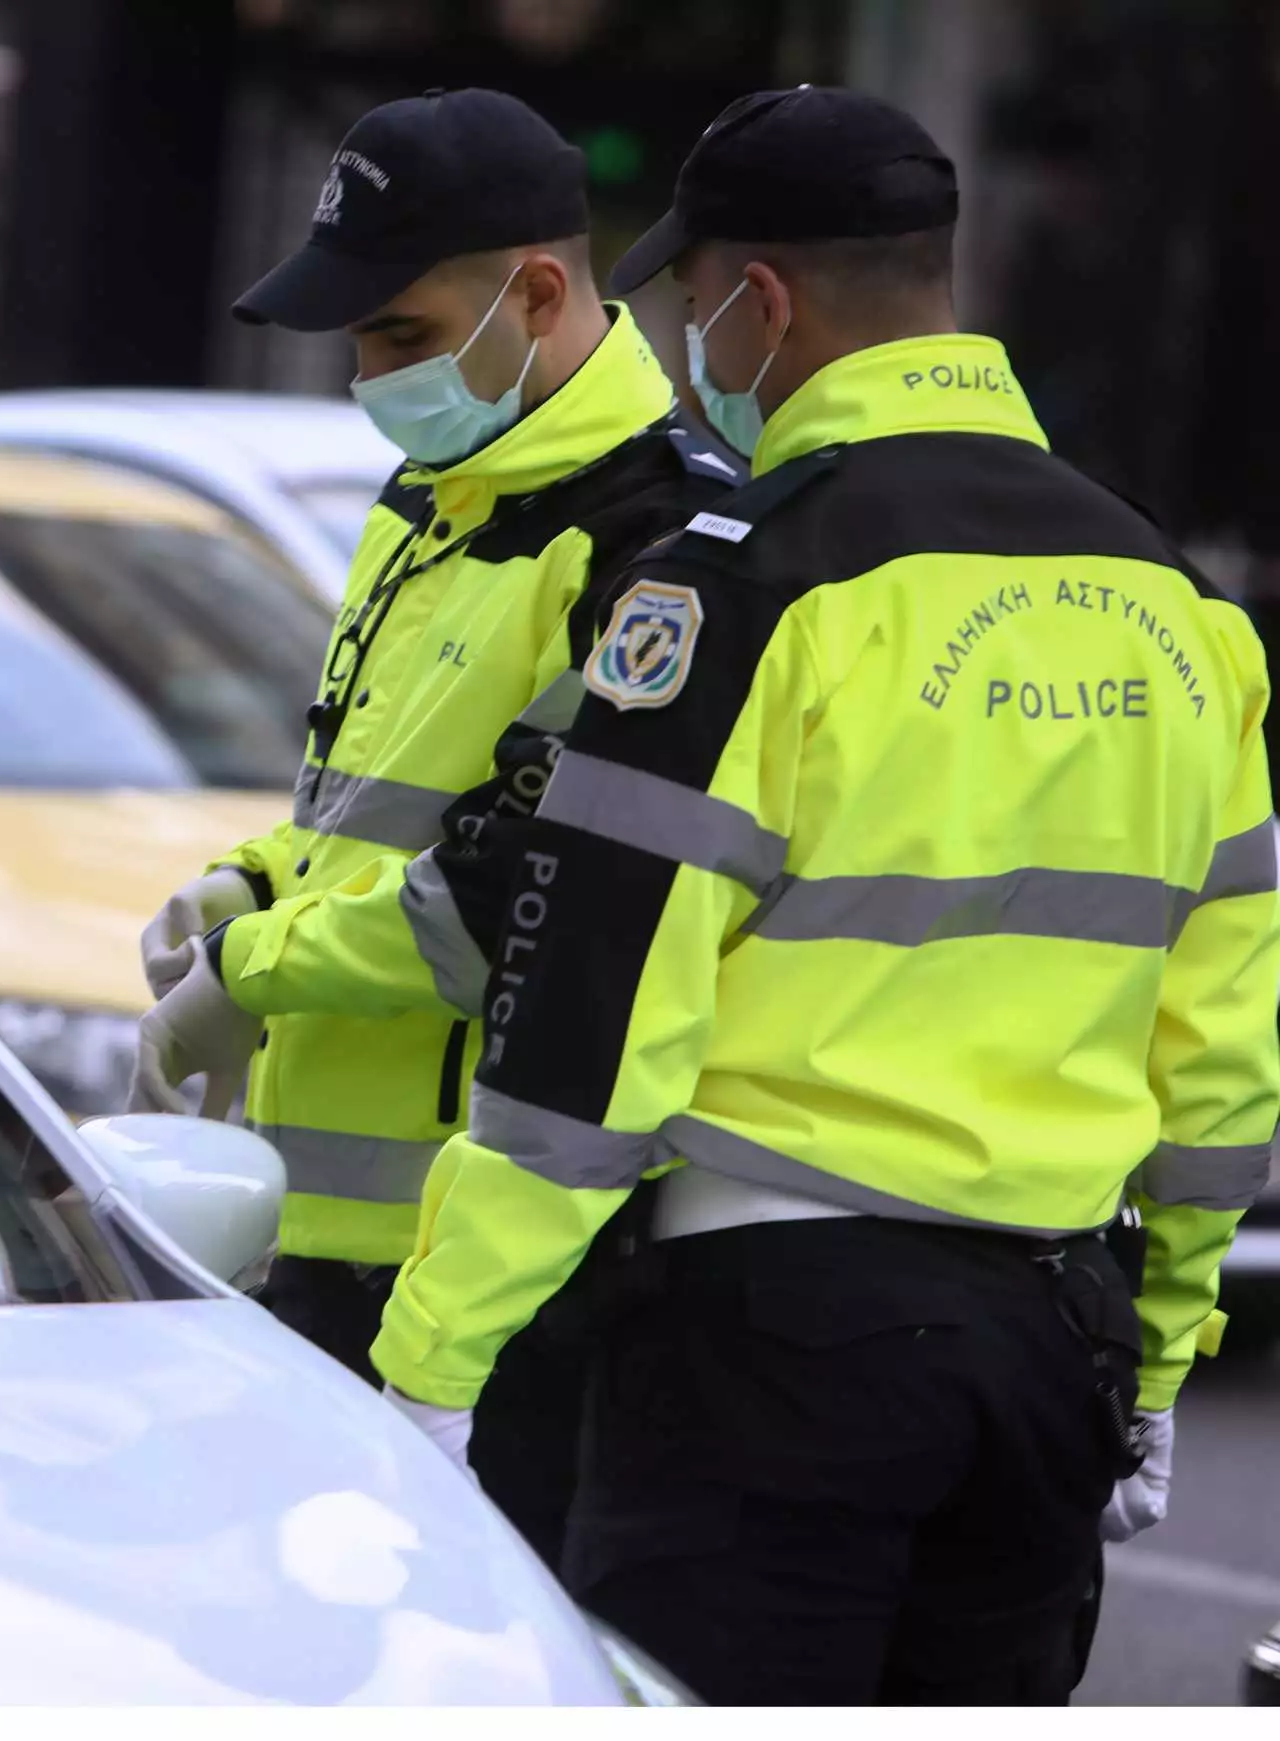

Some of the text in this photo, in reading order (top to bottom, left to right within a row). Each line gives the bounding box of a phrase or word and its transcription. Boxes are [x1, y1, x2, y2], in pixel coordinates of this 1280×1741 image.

[920, 578, 1206, 719] ΕΛΛΗΝΙΚΗ ΑΣΤΥΝΟΜΙΑ
[986, 678, 1148, 719] POLICE
